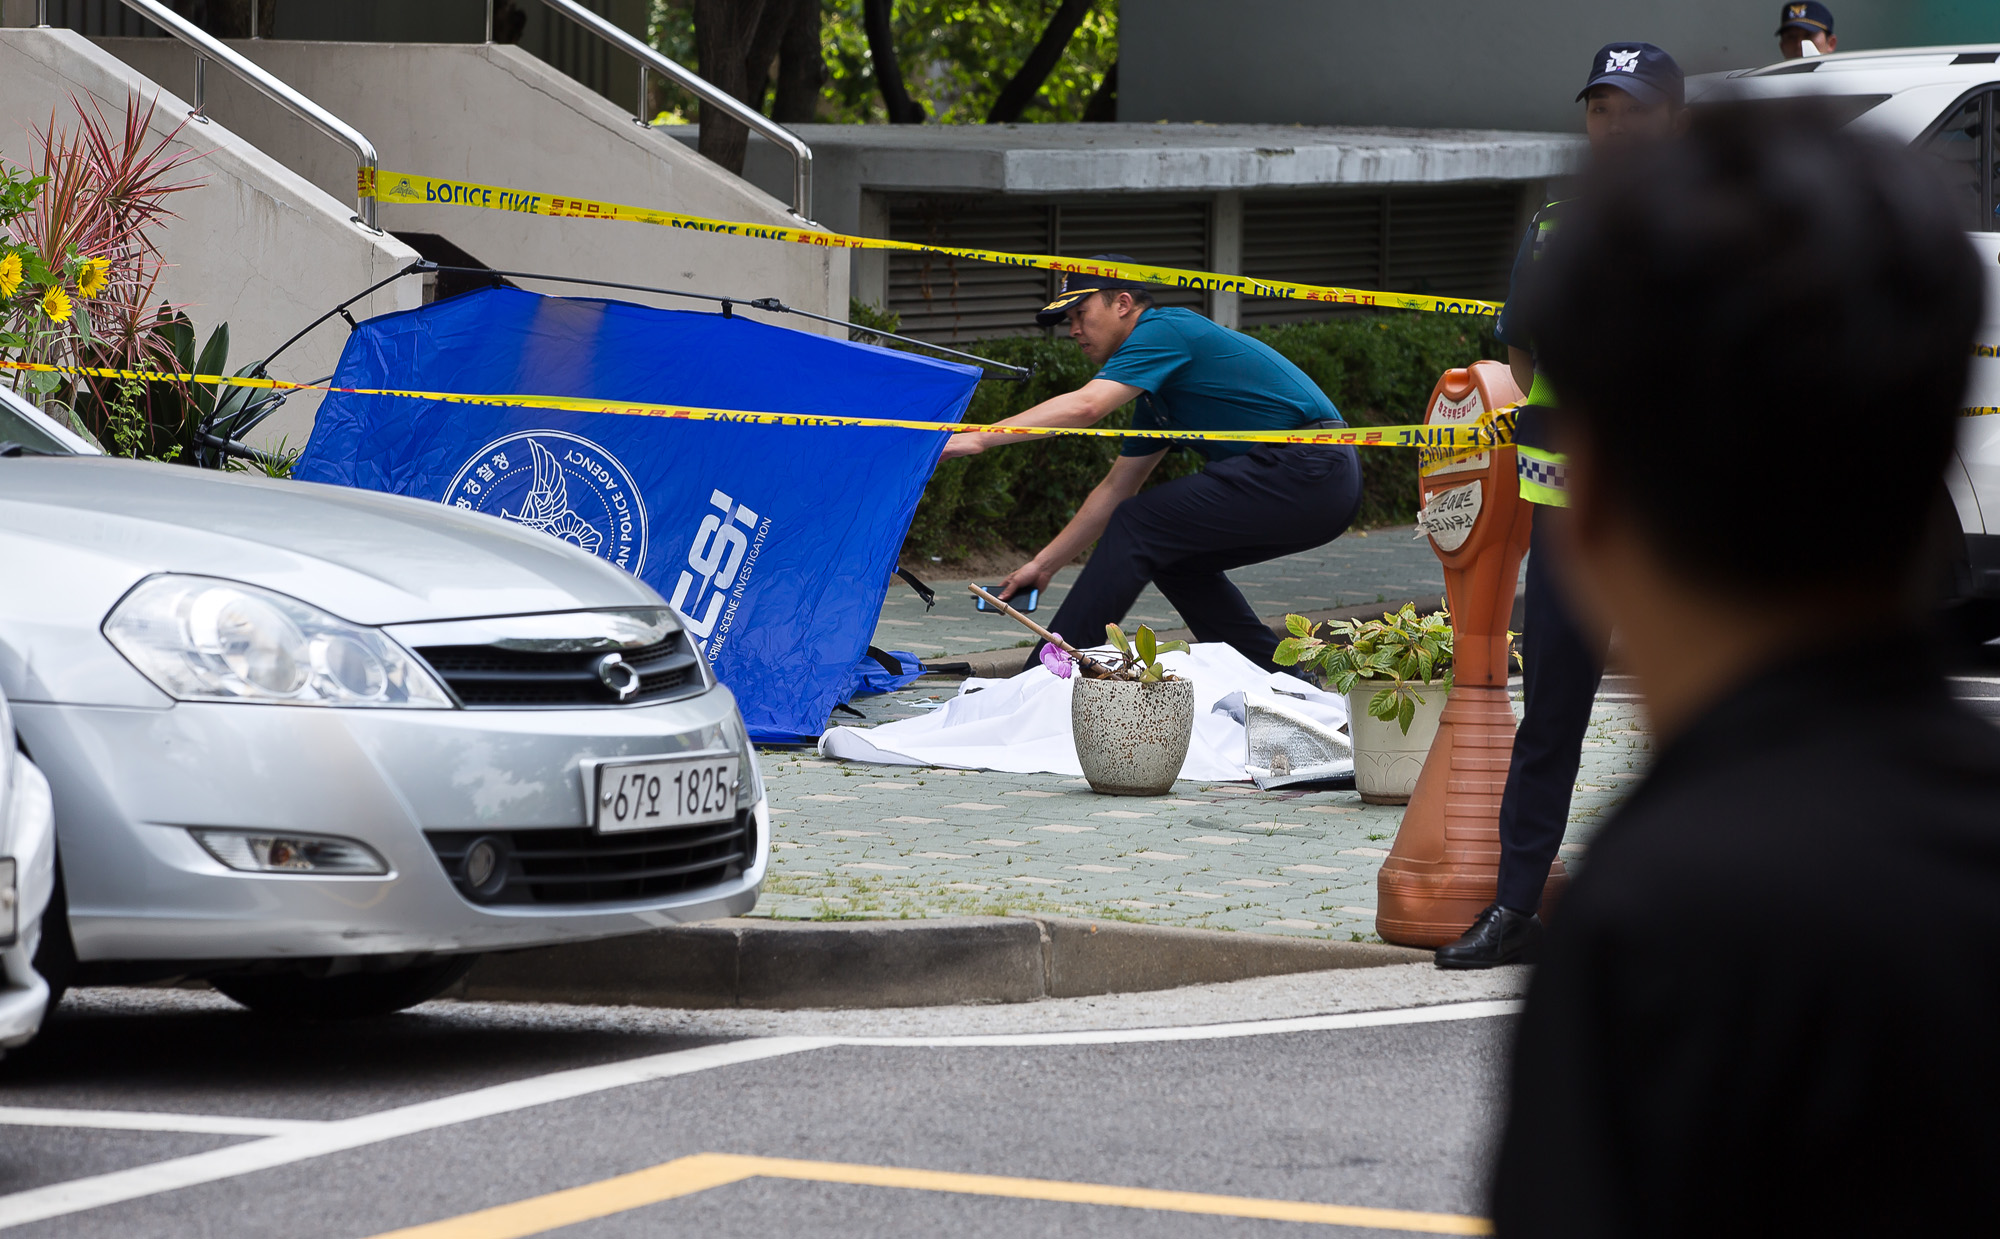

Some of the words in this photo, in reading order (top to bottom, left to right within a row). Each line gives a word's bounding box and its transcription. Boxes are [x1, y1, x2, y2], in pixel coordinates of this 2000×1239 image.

[563, 449, 618, 490] AGENCY
[611, 491, 632, 541] POLICE
[669, 488, 759, 654] CSI
[708, 633, 726, 661] CRIME
[719, 599, 740, 634] SCENE
[733, 516, 772, 599] INVESTIGATION
[613, 773, 661, 822] 67오
[673, 766, 728, 817] 1825
